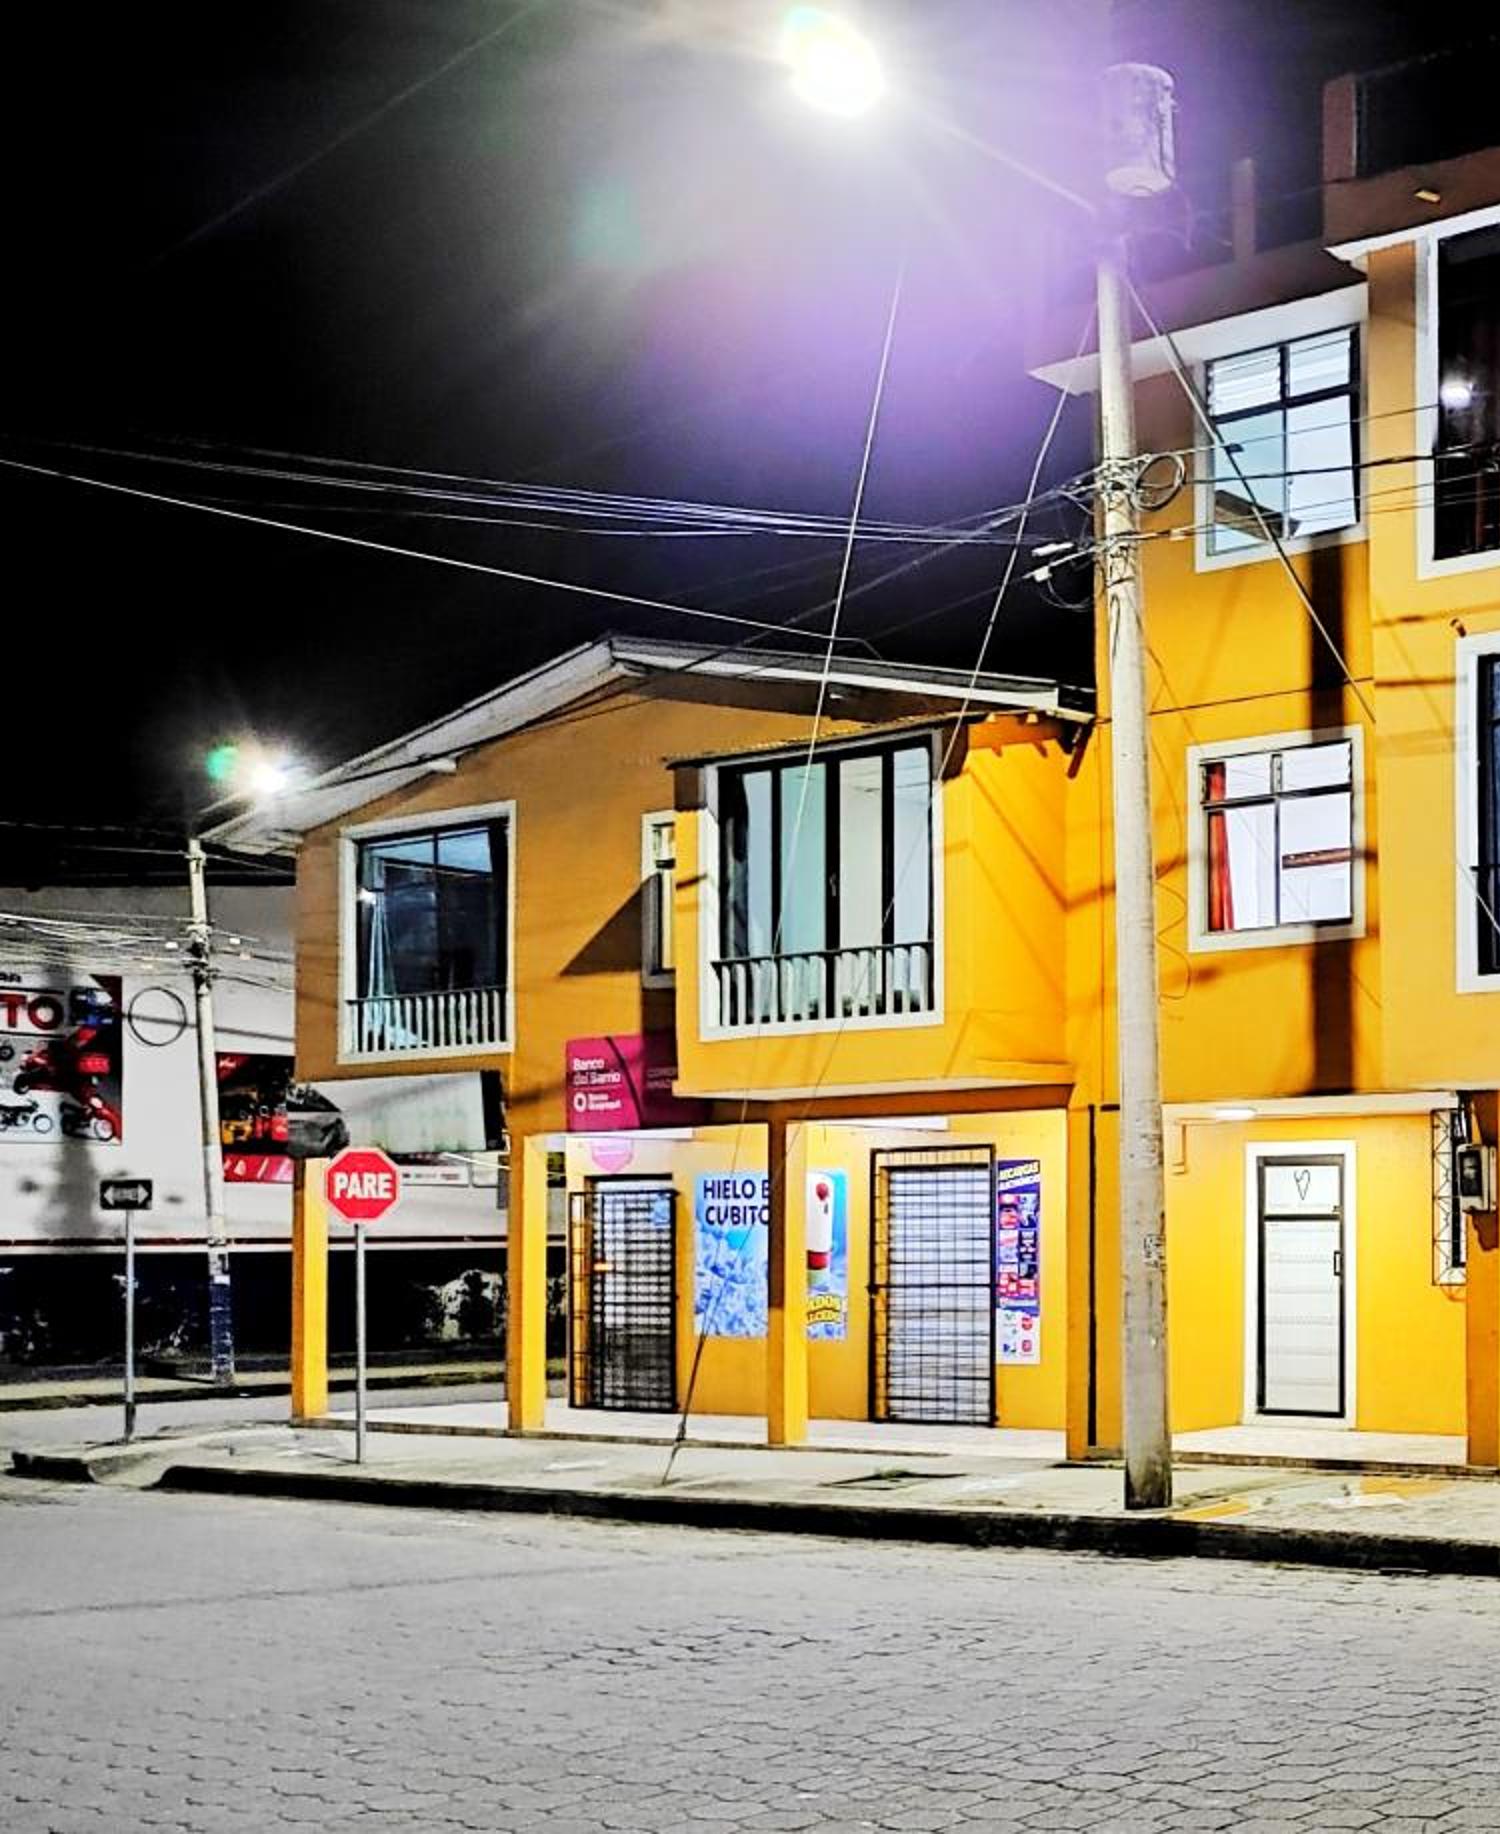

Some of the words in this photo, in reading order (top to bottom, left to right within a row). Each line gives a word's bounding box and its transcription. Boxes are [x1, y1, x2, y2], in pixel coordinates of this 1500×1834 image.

[0, 993, 64, 1030] TO
[573, 1058, 605, 1071] Banco
[334, 1171, 393, 1200] PARE
[703, 1179, 756, 1200] HIELO
[705, 1205, 770, 1226] CUBITO
